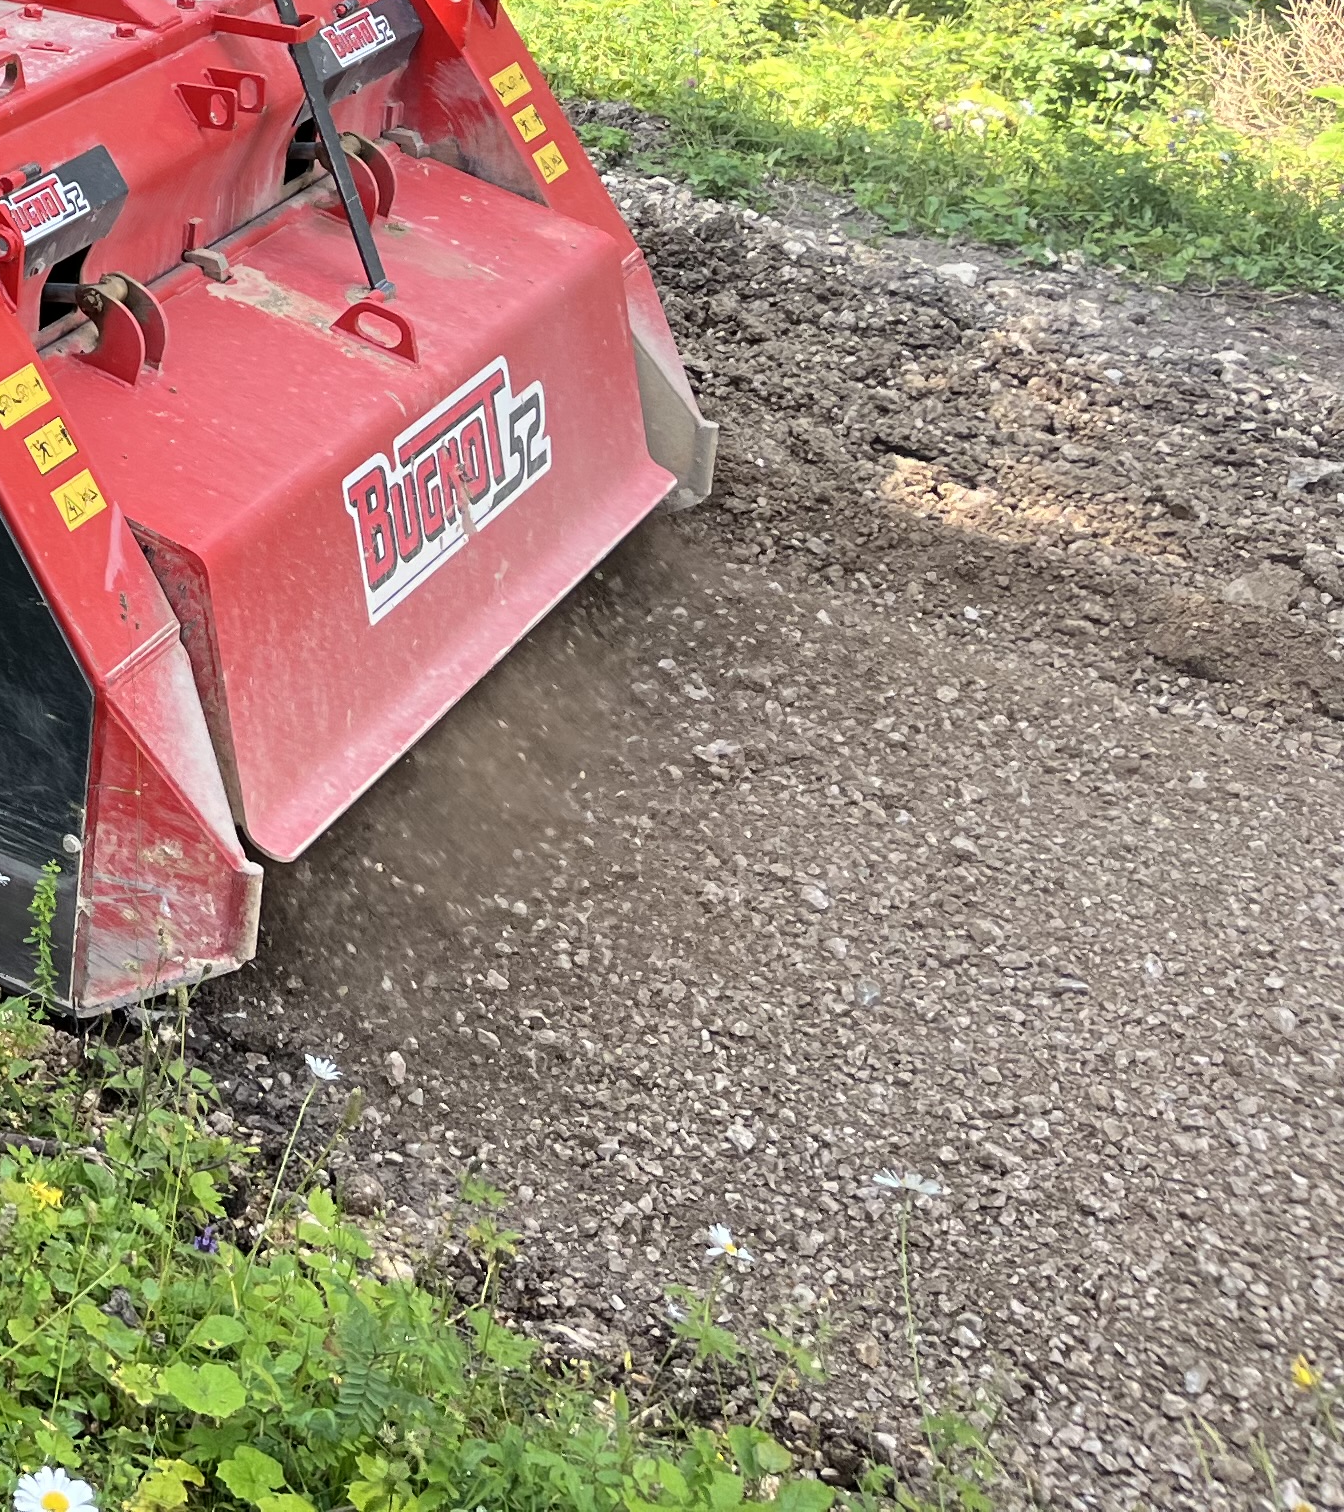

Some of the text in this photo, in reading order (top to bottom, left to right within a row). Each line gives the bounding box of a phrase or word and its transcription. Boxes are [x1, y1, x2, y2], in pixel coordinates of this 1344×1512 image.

[322, 10, 379, 59] BUGNOT
[11, 177, 88, 233] UGNOT 52
[348, 368, 548, 592] BUGNOT 52
